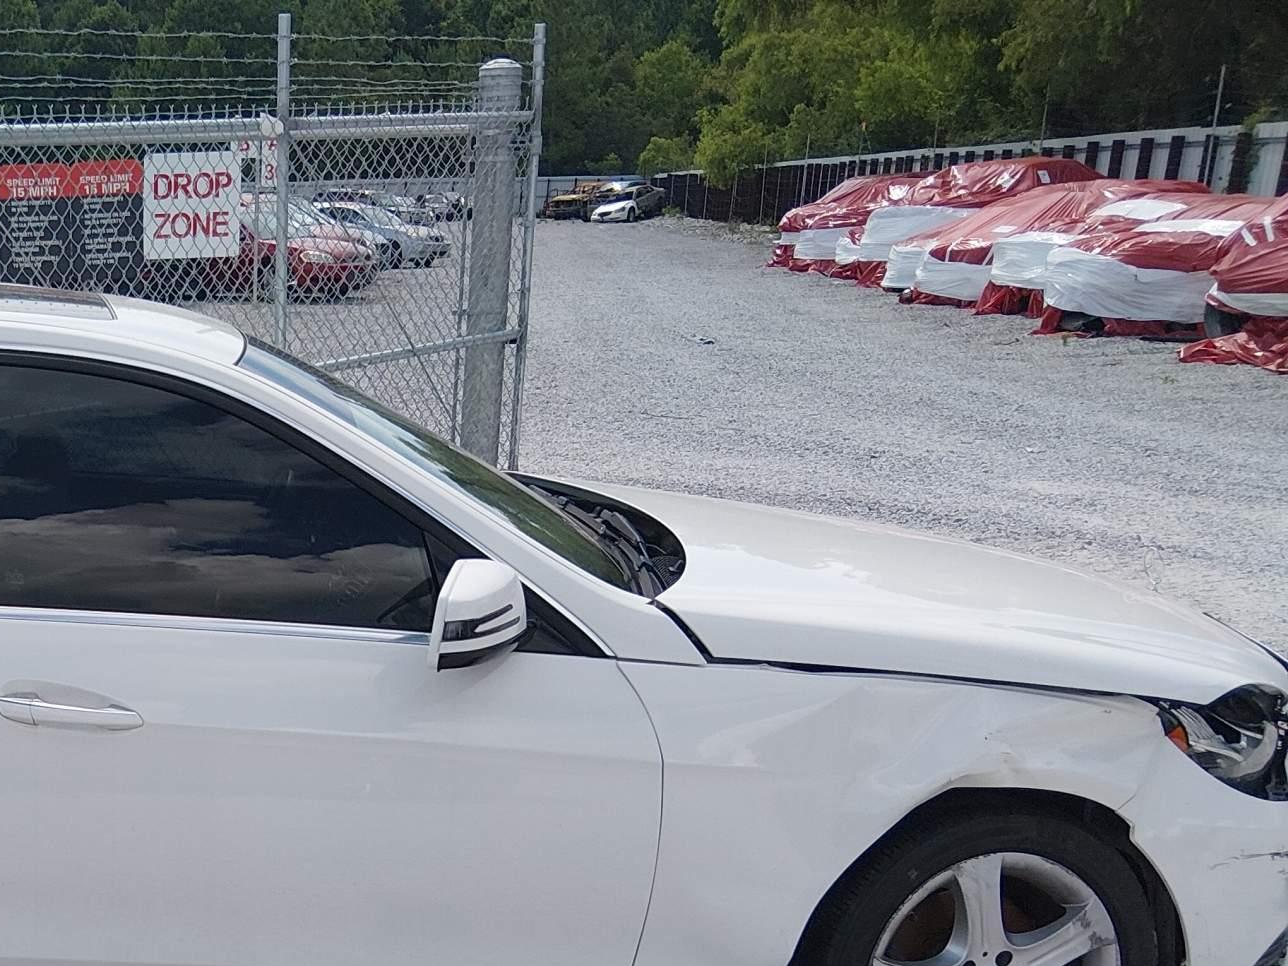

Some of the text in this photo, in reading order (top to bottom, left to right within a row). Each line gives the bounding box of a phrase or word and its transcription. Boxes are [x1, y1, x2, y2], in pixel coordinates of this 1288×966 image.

[7, 177, 60, 187] SPEED LIMIT
[79, 173, 133, 184] SPEED LIMIT
[12, 186, 57, 198] 15 MPH
[84, 182, 130, 195] 15 MPH
[153, 172, 232, 200] DROP
[153, 211, 229, 239] ZONE
